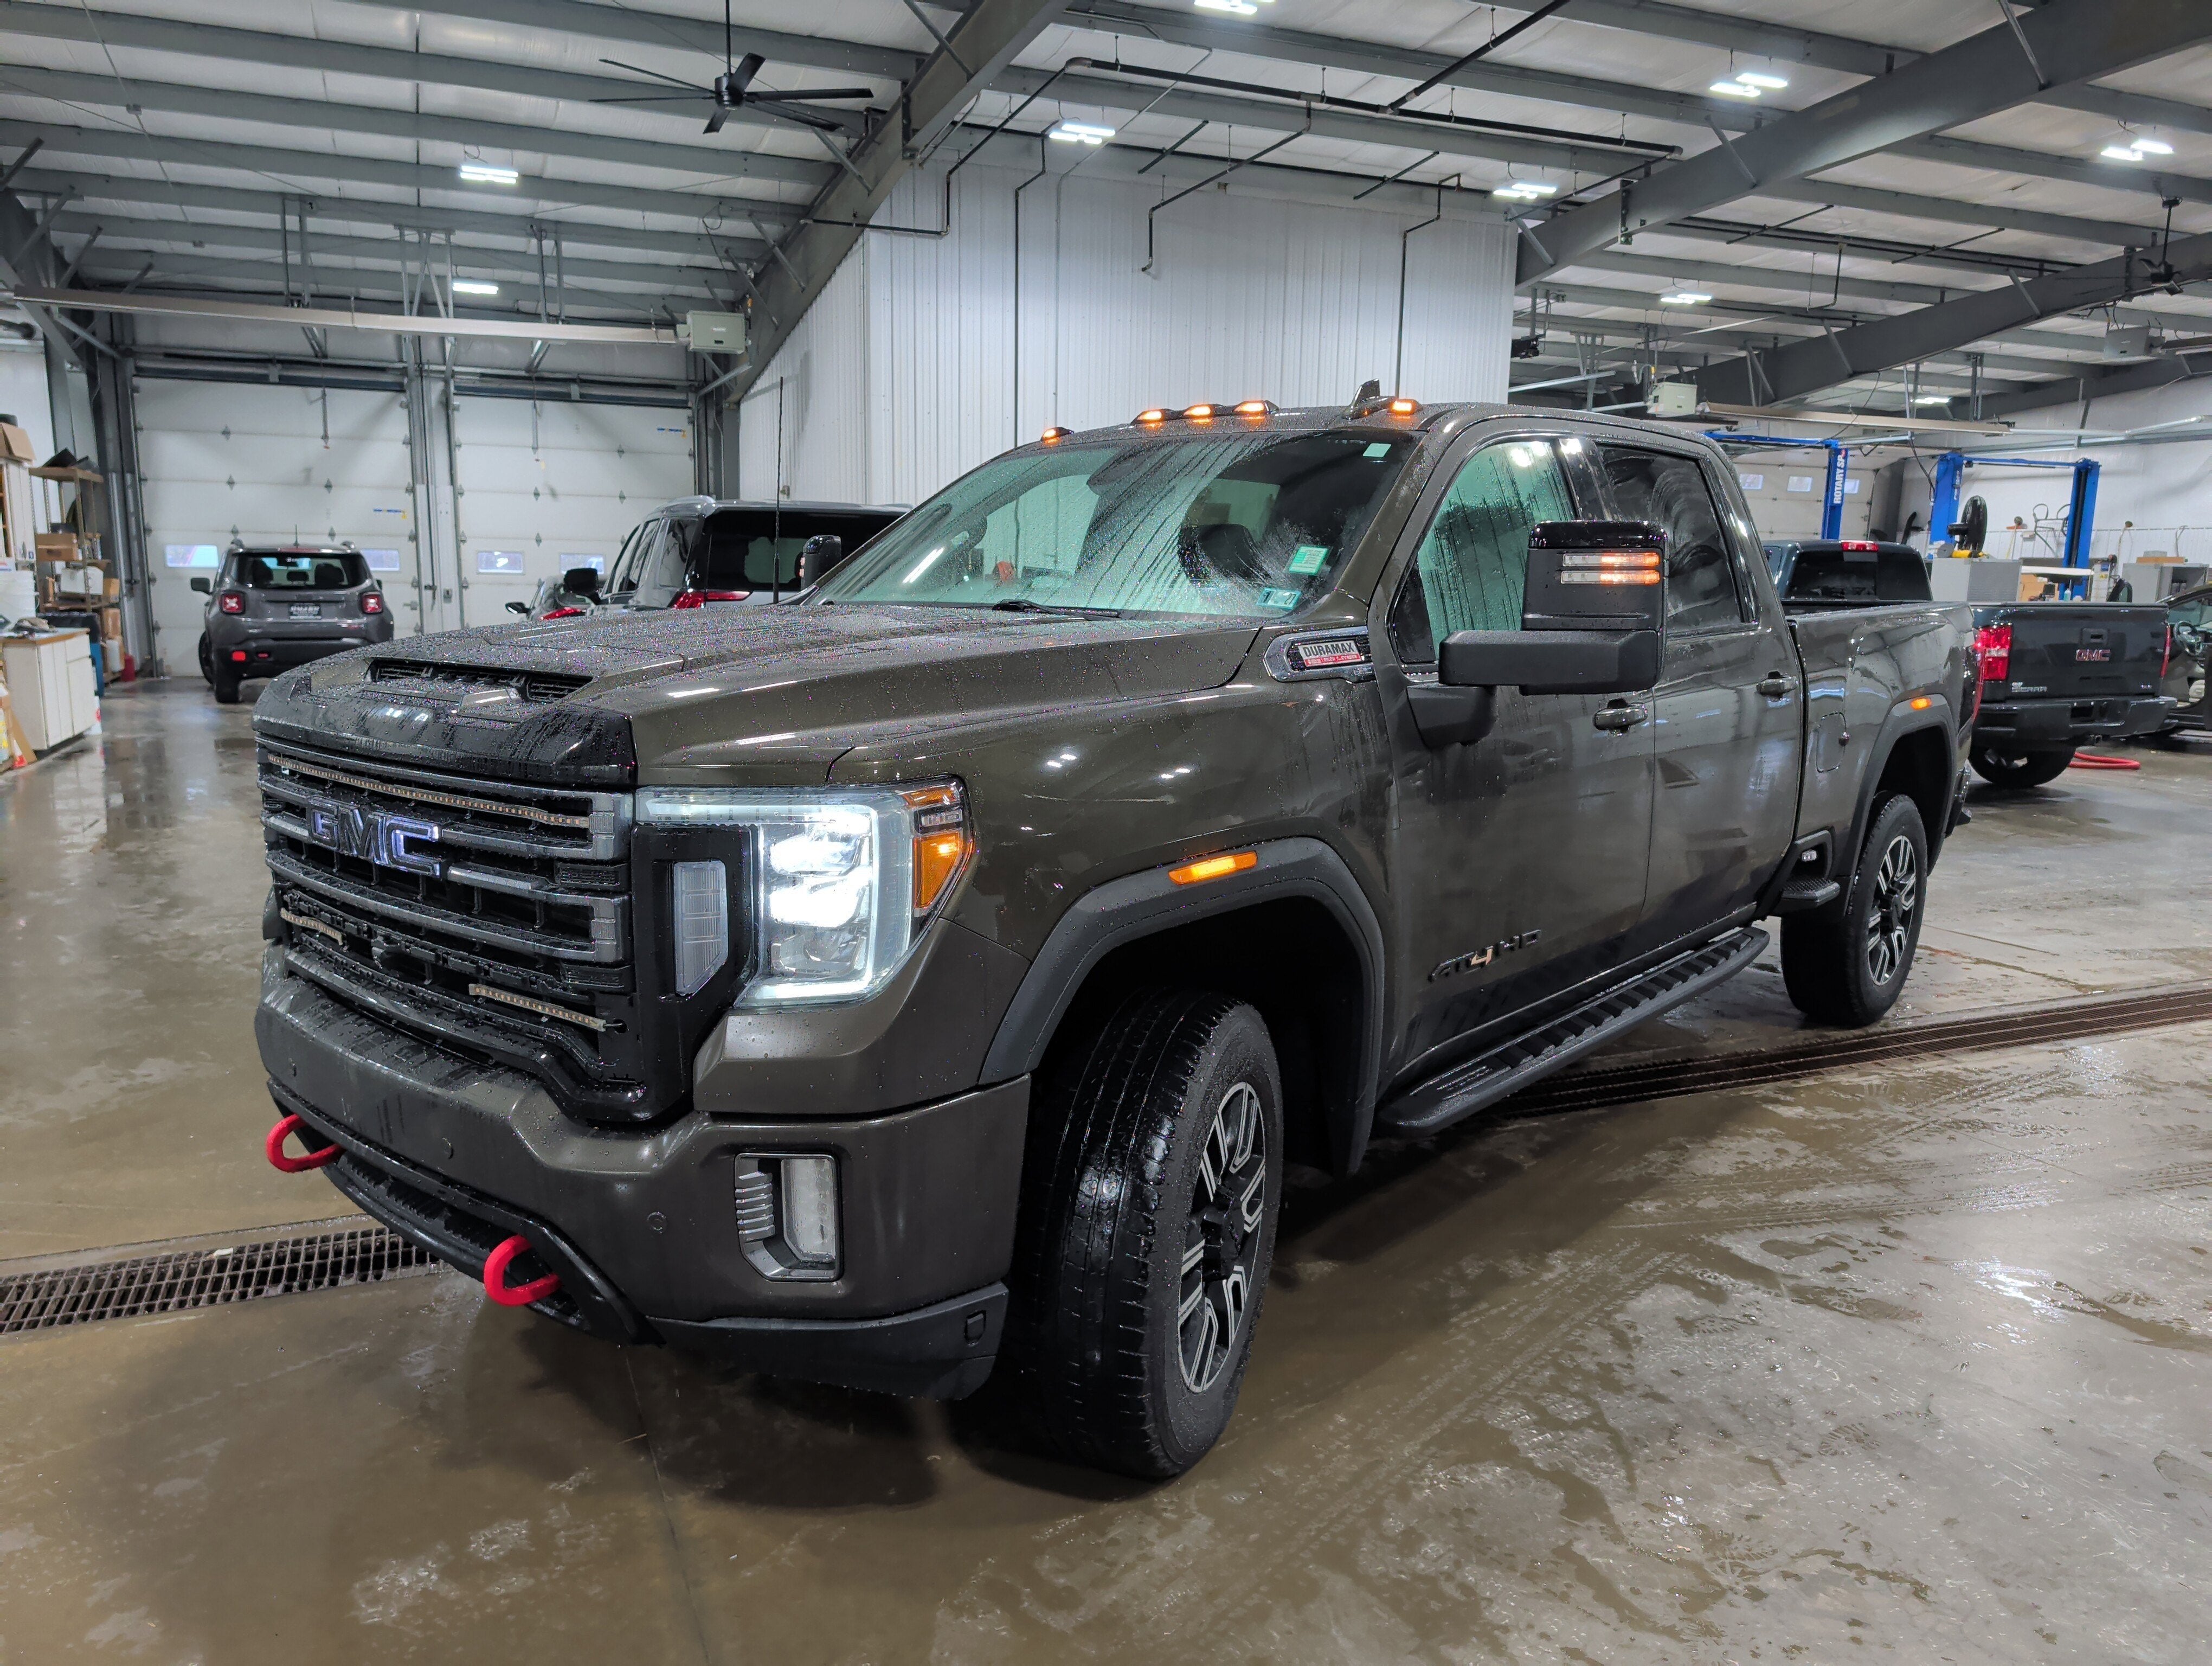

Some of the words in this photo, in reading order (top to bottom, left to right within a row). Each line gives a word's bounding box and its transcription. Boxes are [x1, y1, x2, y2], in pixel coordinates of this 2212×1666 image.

[1833, 467, 1844, 504] ROTARY
[1303, 642, 1355, 657] DURAMAX
[2075, 649, 2111, 661] GMC
[307, 796, 440, 879] GMC
